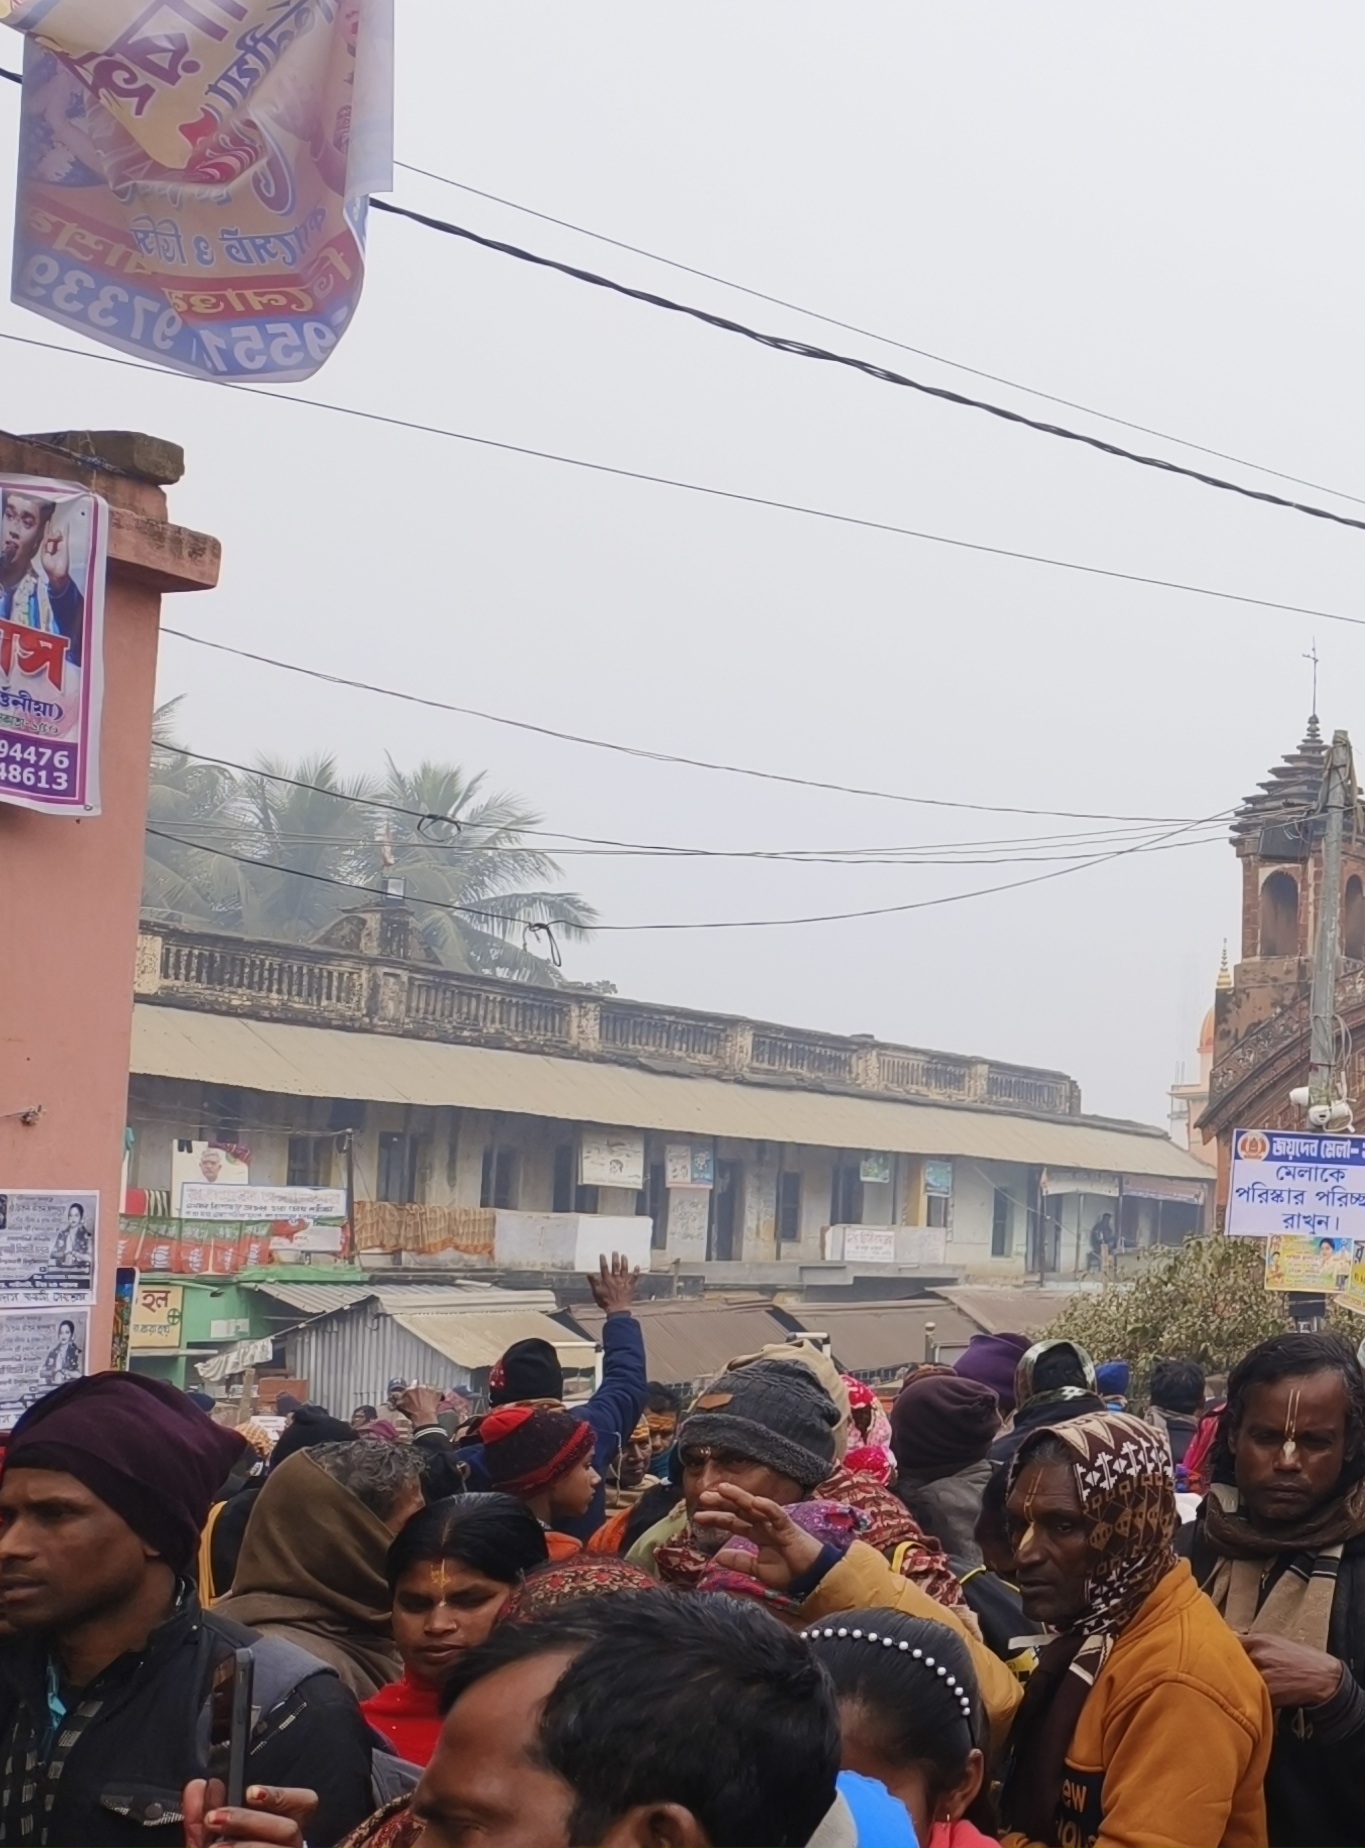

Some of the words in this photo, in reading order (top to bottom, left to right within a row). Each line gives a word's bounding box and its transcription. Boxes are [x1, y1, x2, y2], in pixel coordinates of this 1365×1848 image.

[0, 739, 70, 769] 94476
[1272, 1136, 1319, 1160] জয়দেব
[1276, 1165, 1349, 1183] মেলাকে
[1063, 1779, 1087, 1814] ew
